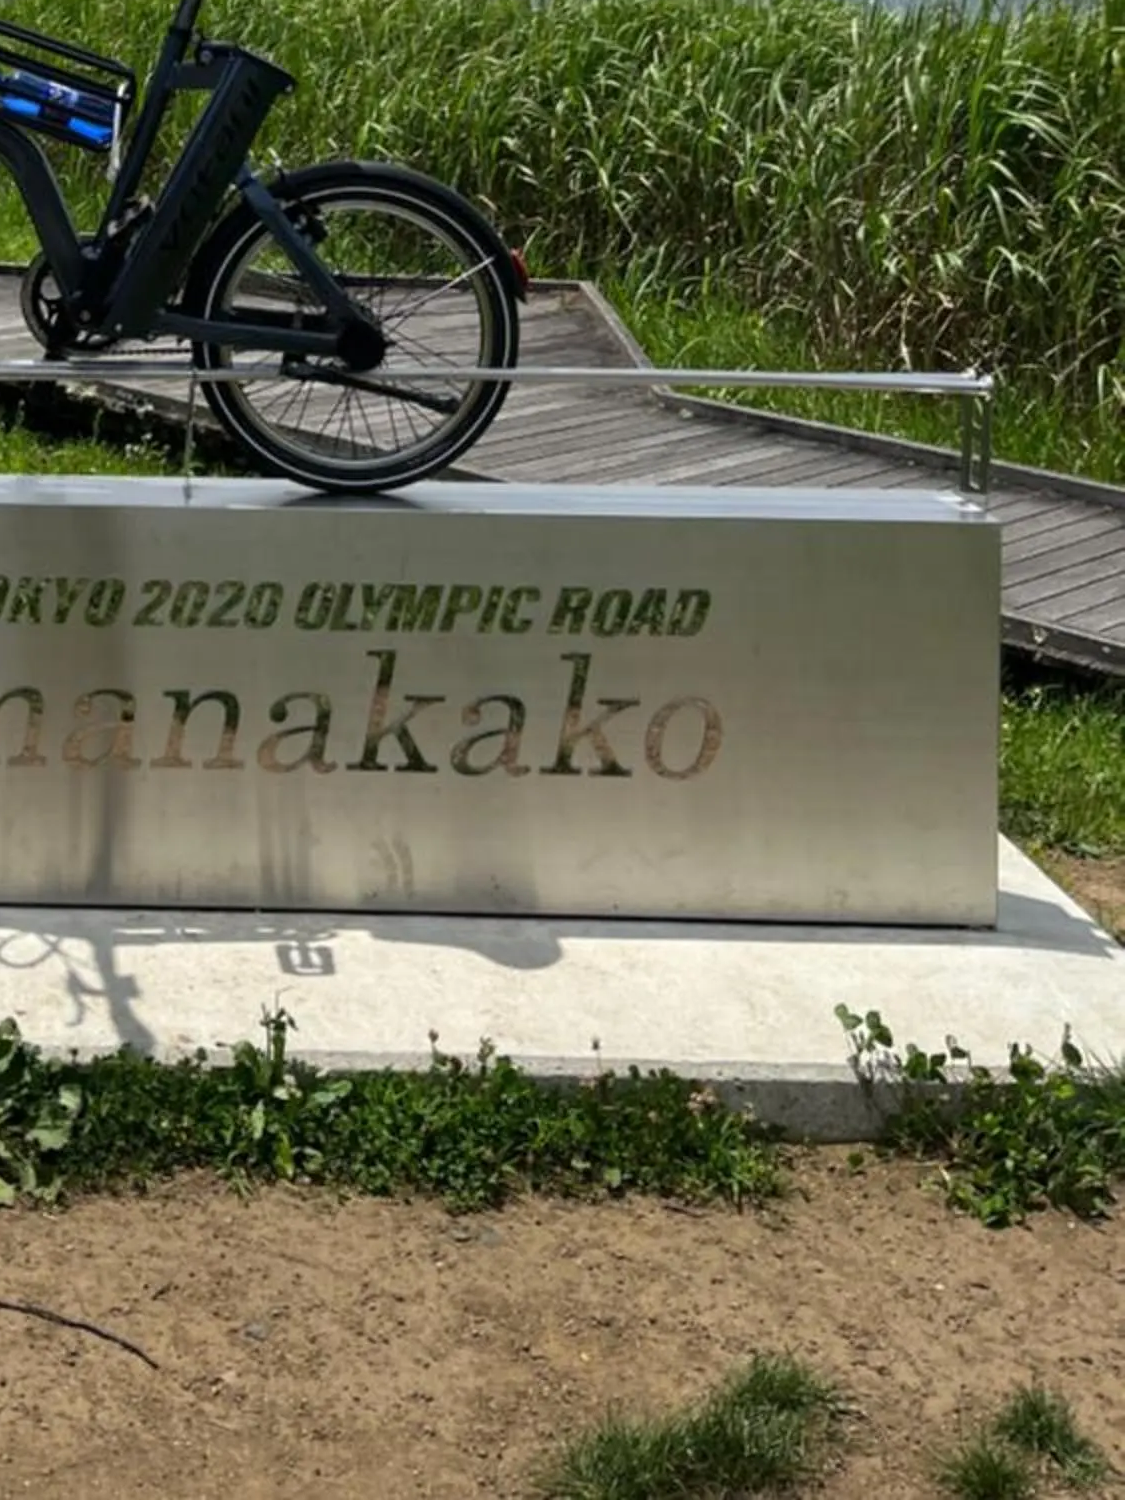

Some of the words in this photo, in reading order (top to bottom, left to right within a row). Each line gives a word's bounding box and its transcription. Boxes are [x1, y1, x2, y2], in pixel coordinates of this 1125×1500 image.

[132, 578, 285, 630] 2020
[292, 581, 542, 634] OLYMPIC
[546, 586, 713, 639] ROAD
